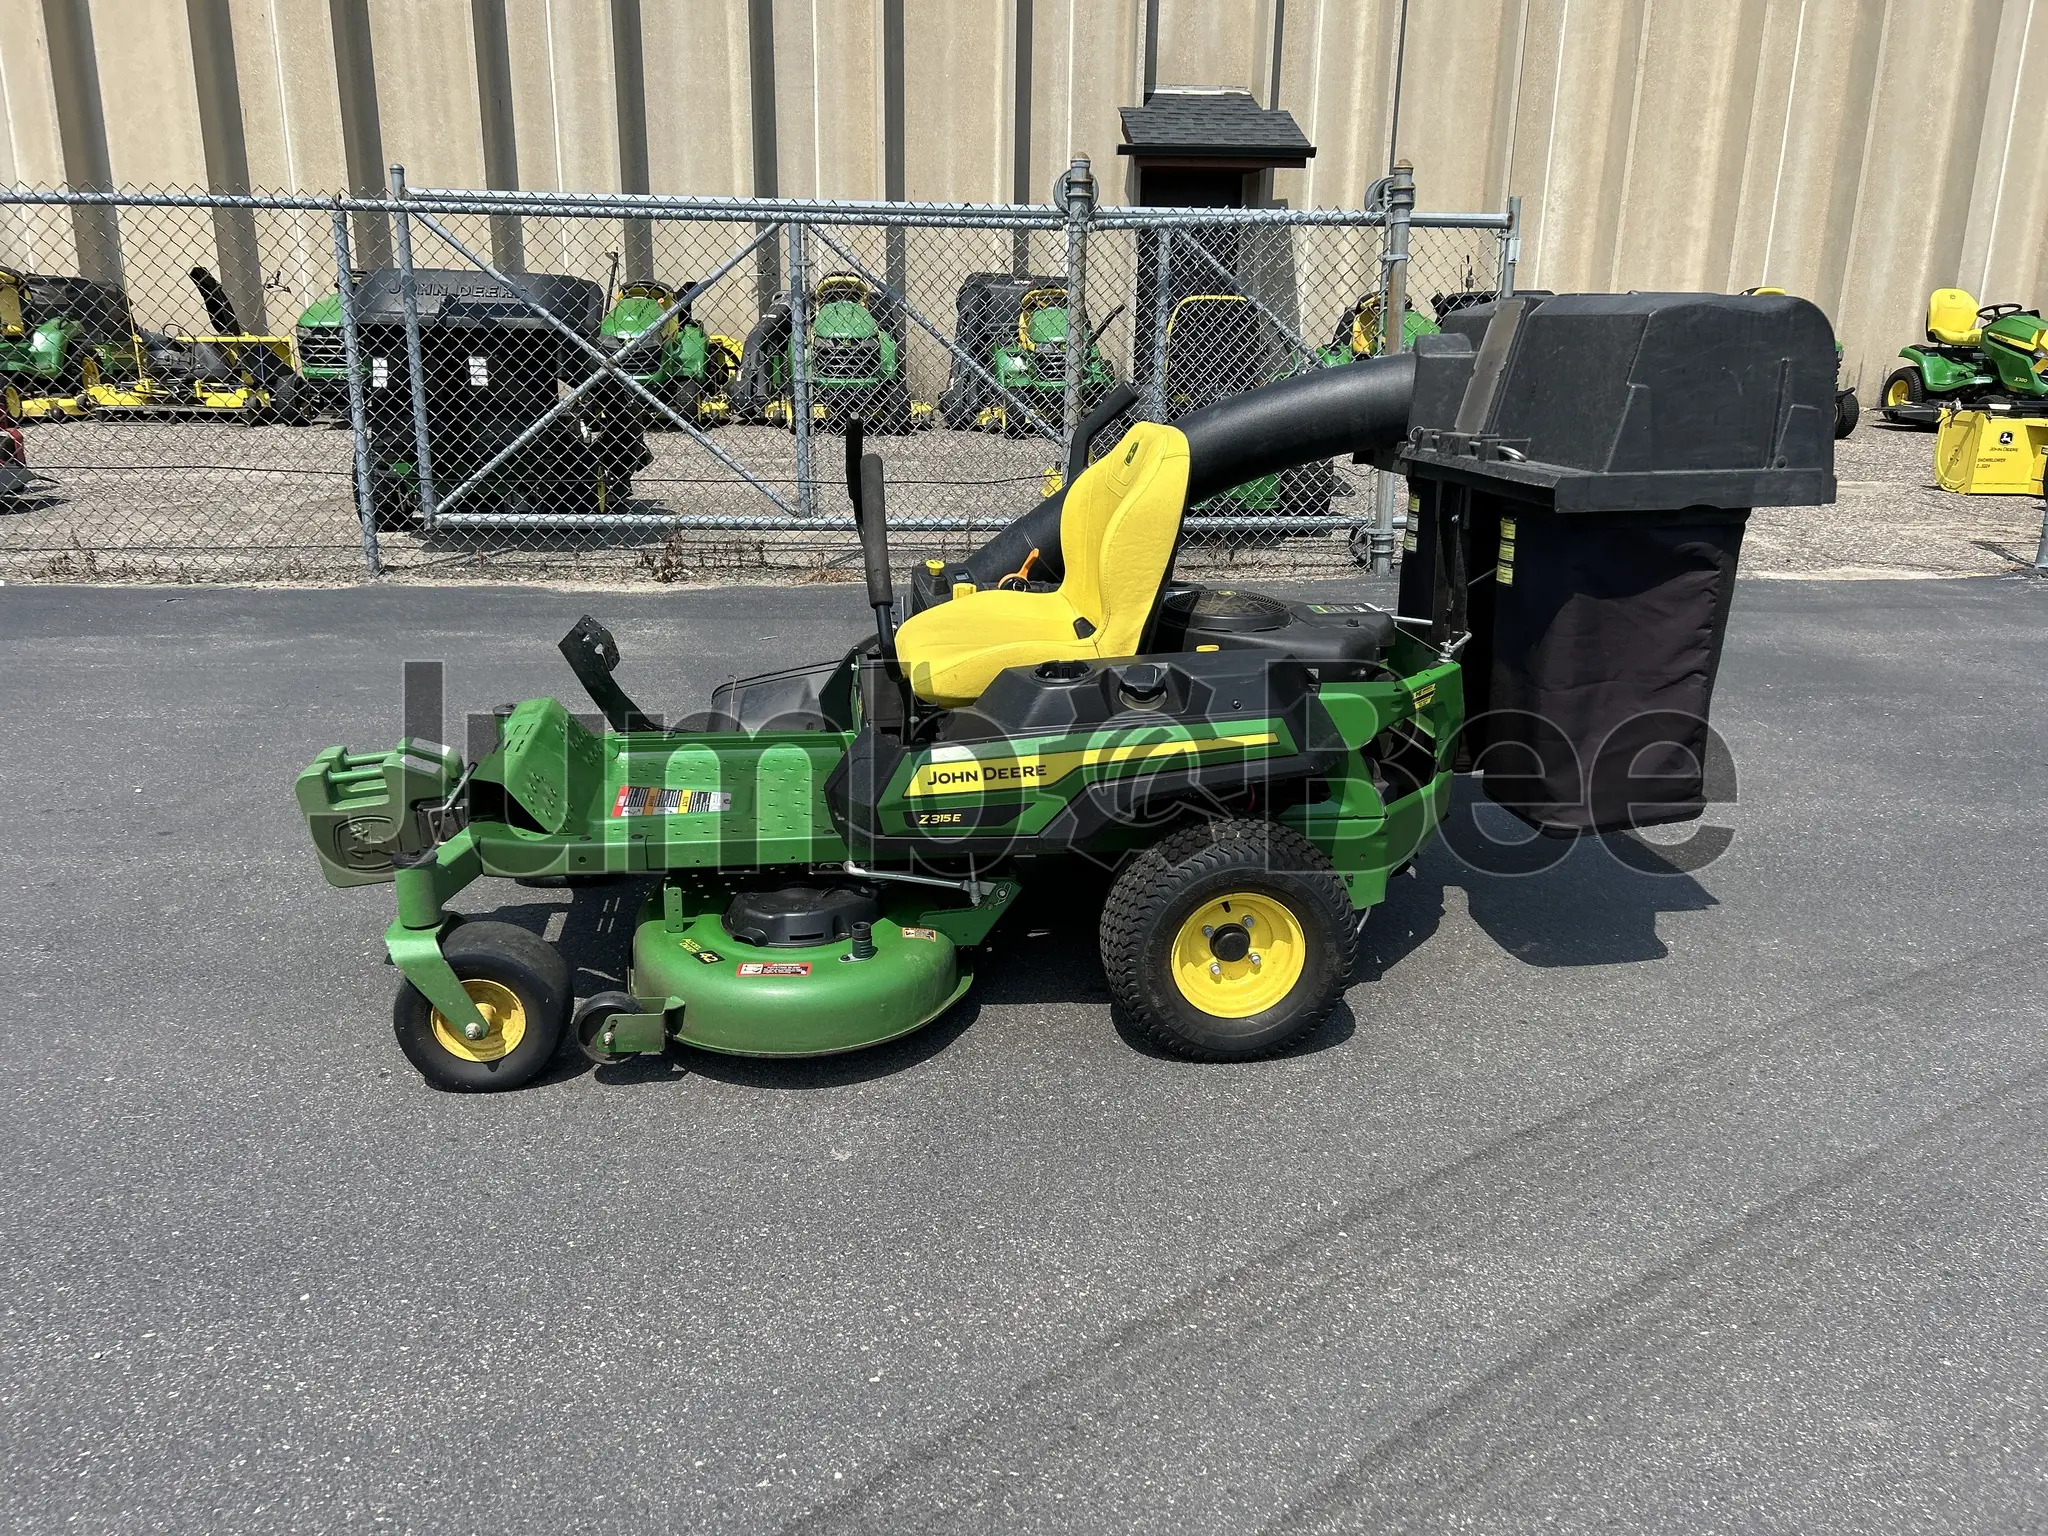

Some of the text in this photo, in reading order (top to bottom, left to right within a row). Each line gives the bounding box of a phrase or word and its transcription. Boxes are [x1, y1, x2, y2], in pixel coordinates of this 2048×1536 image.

[459, 284, 521, 299] DEER
[927, 765, 1047, 785] JOHN DEERE
